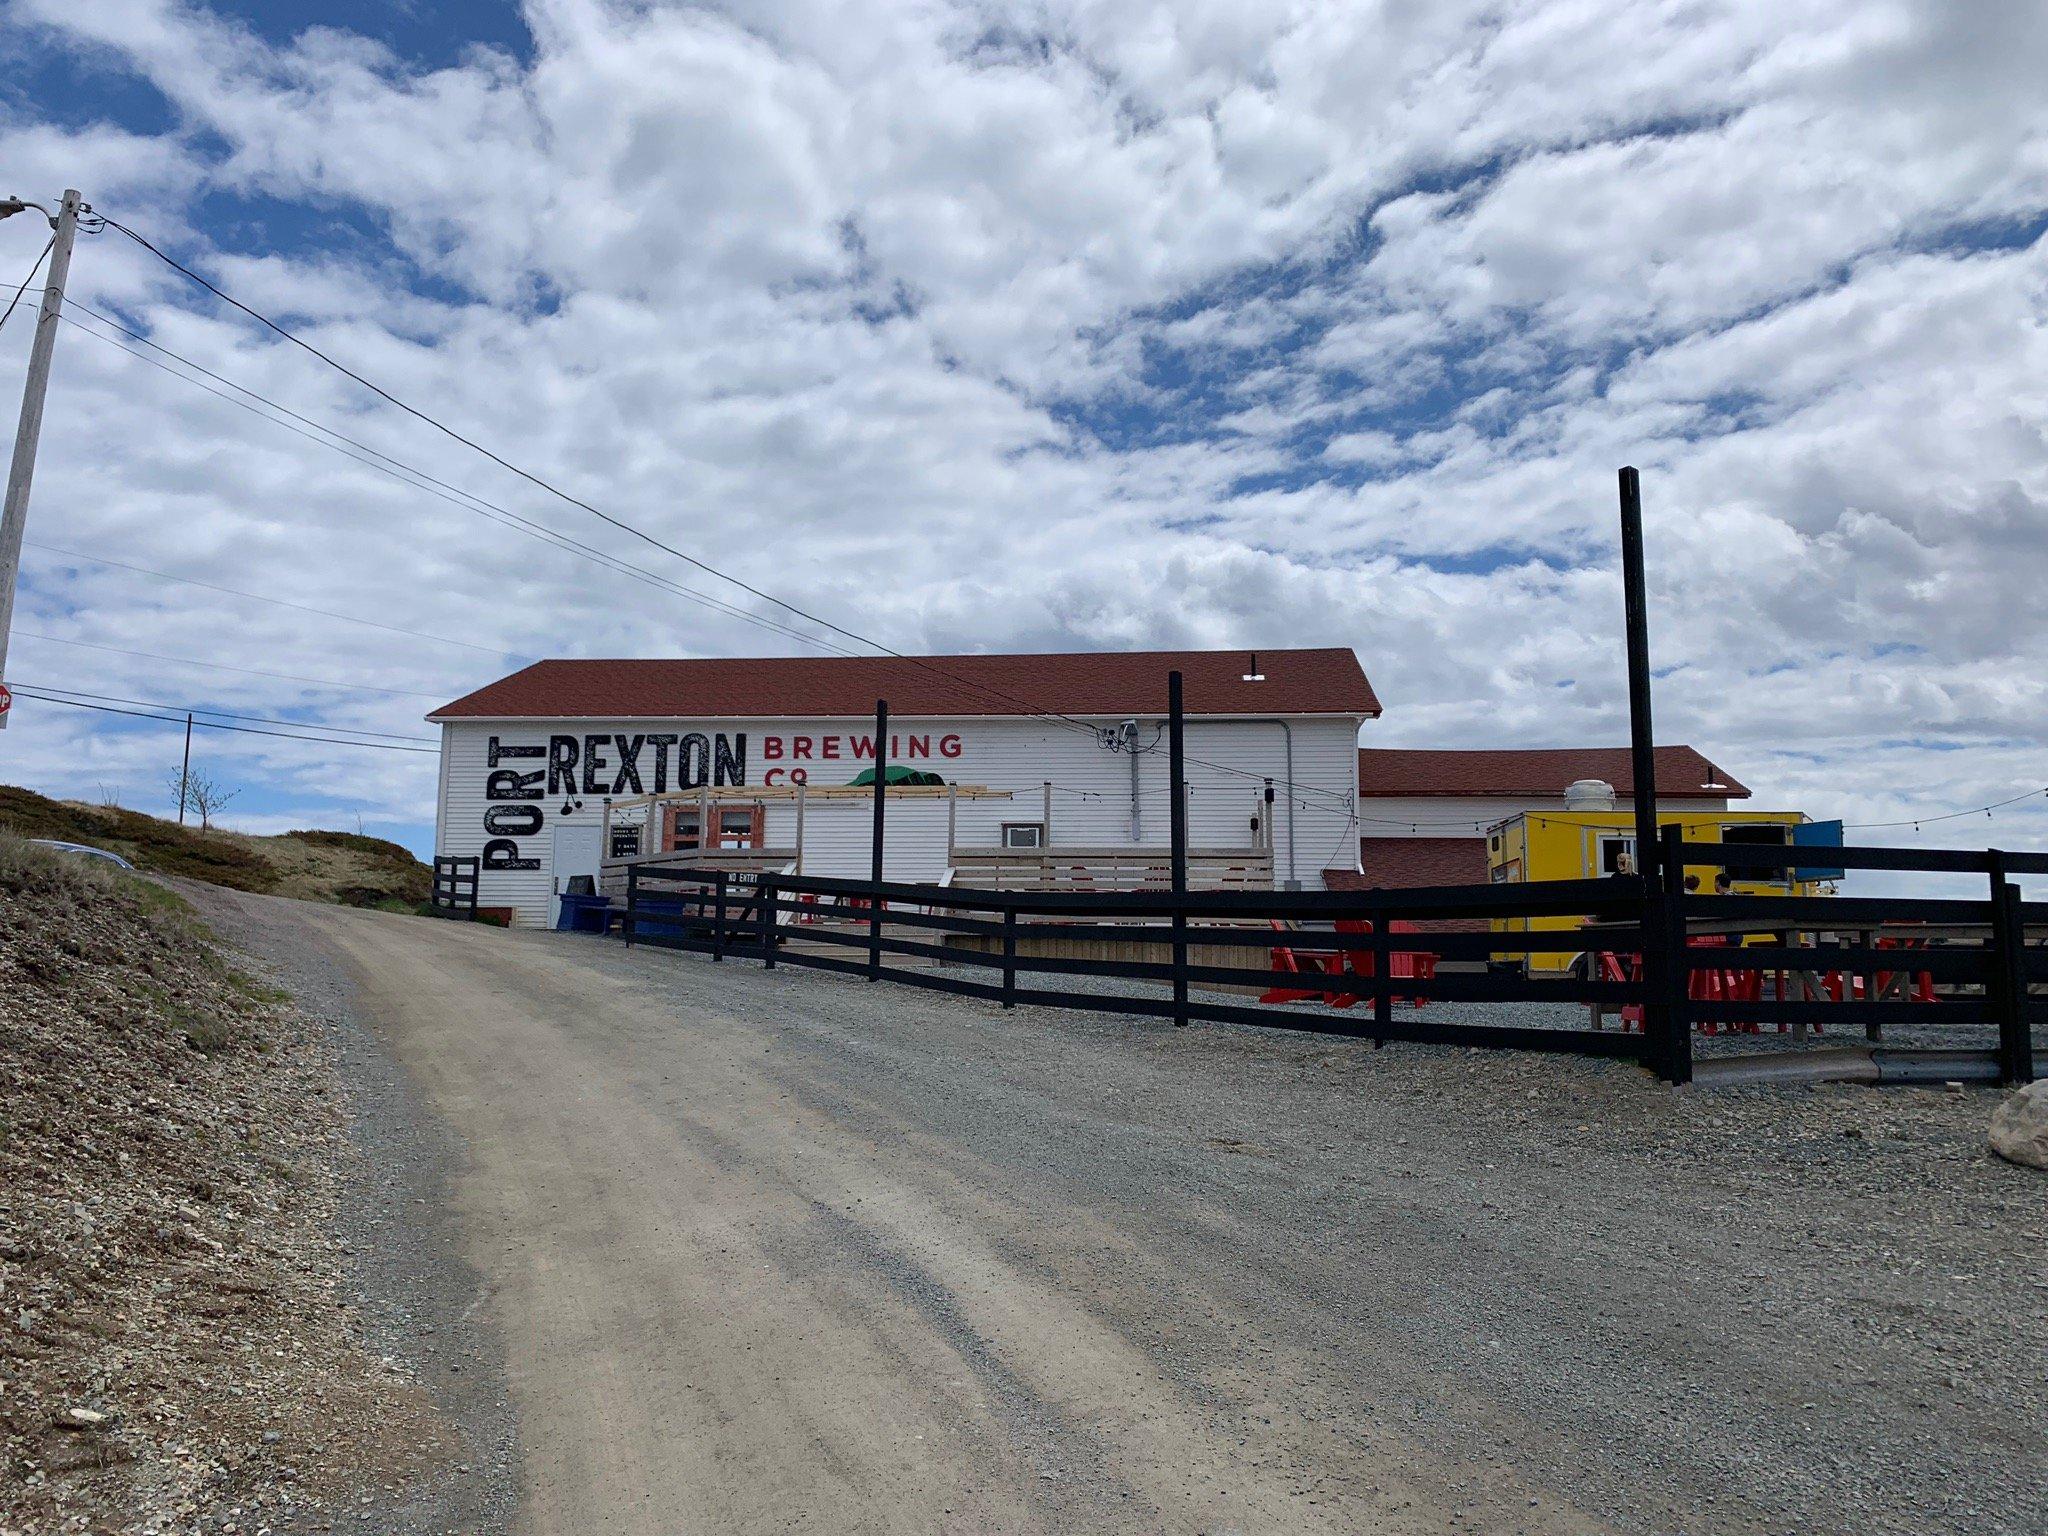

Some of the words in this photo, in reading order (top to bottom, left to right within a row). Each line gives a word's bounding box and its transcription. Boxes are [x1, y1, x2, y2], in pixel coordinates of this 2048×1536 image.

[548, 733, 747, 795] REXTON
[764, 734, 962, 760] BREWING
[482, 736, 547, 870] PORT
[728, 873, 736, 882] NO
[739, 873, 758, 883] ENTRY
